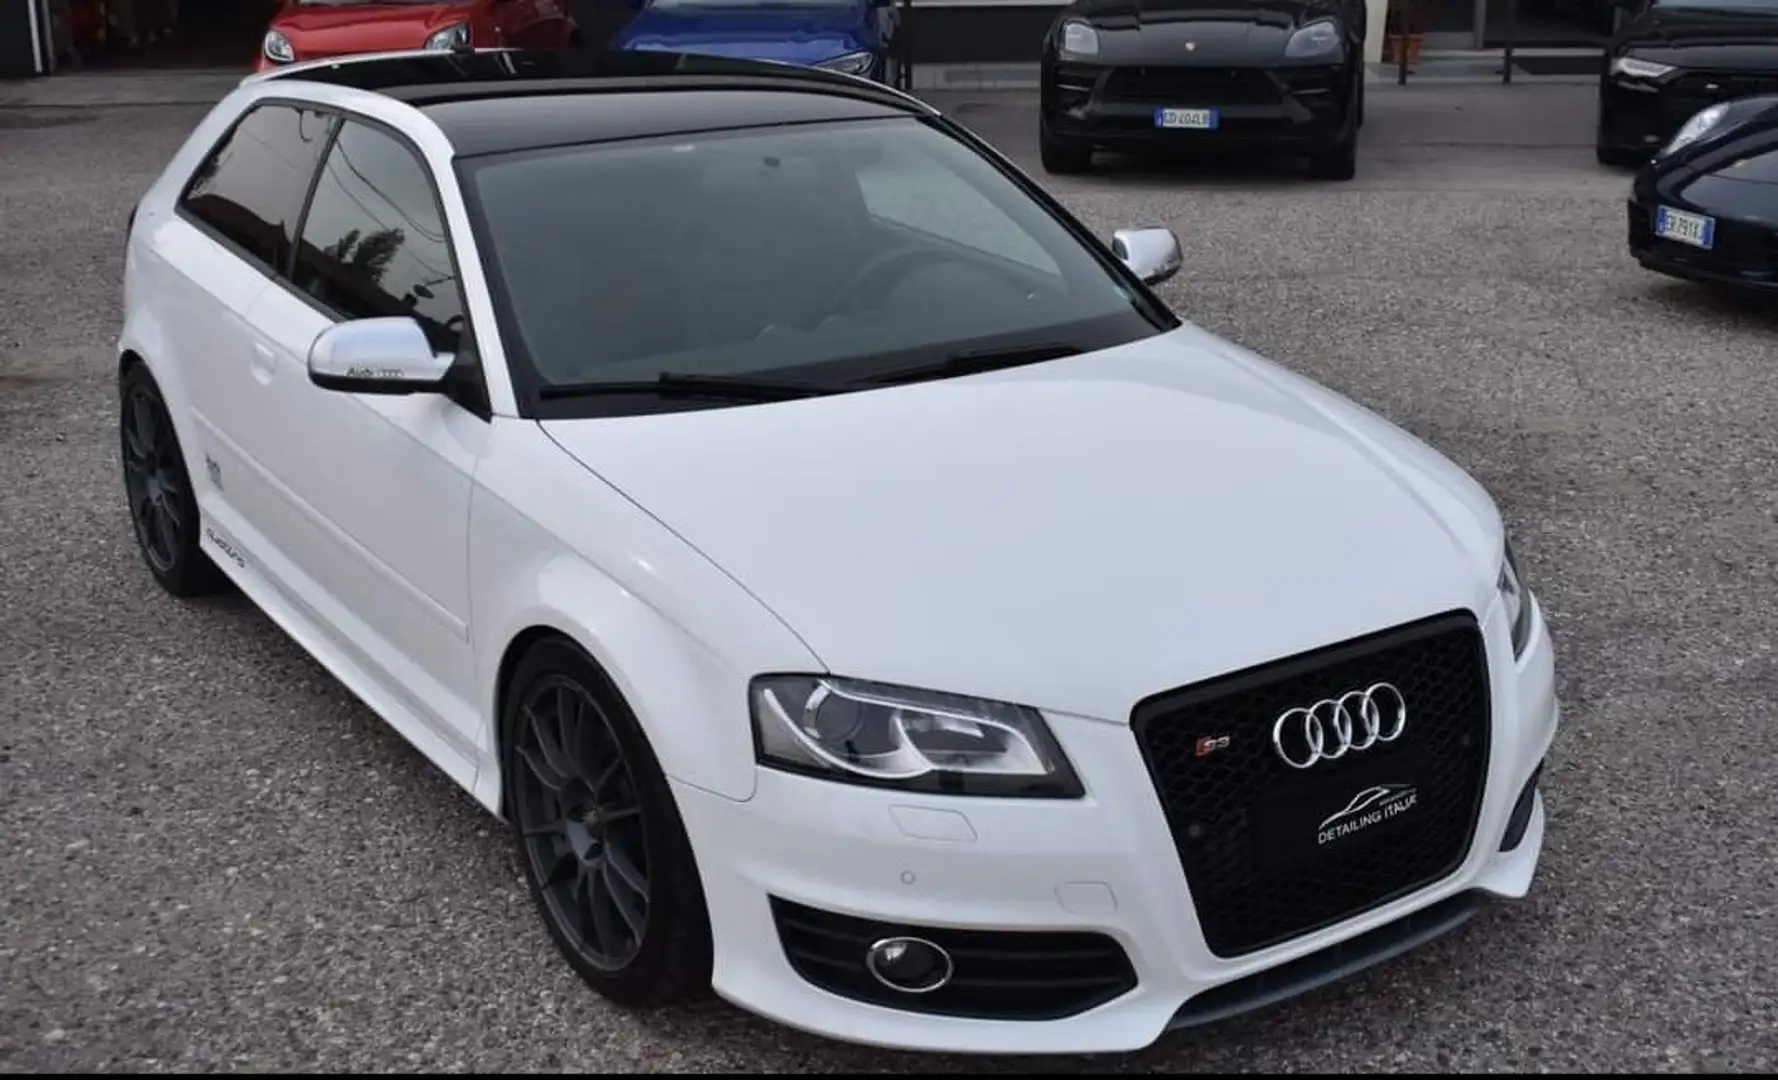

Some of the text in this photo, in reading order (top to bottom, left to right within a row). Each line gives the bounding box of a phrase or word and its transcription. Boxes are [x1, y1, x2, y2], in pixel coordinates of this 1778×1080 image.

[1201, 736, 1230, 752] S3
[1318, 810, 1382, 845] DETAILING
[1384, 795, 1417, 819] ITALIA
